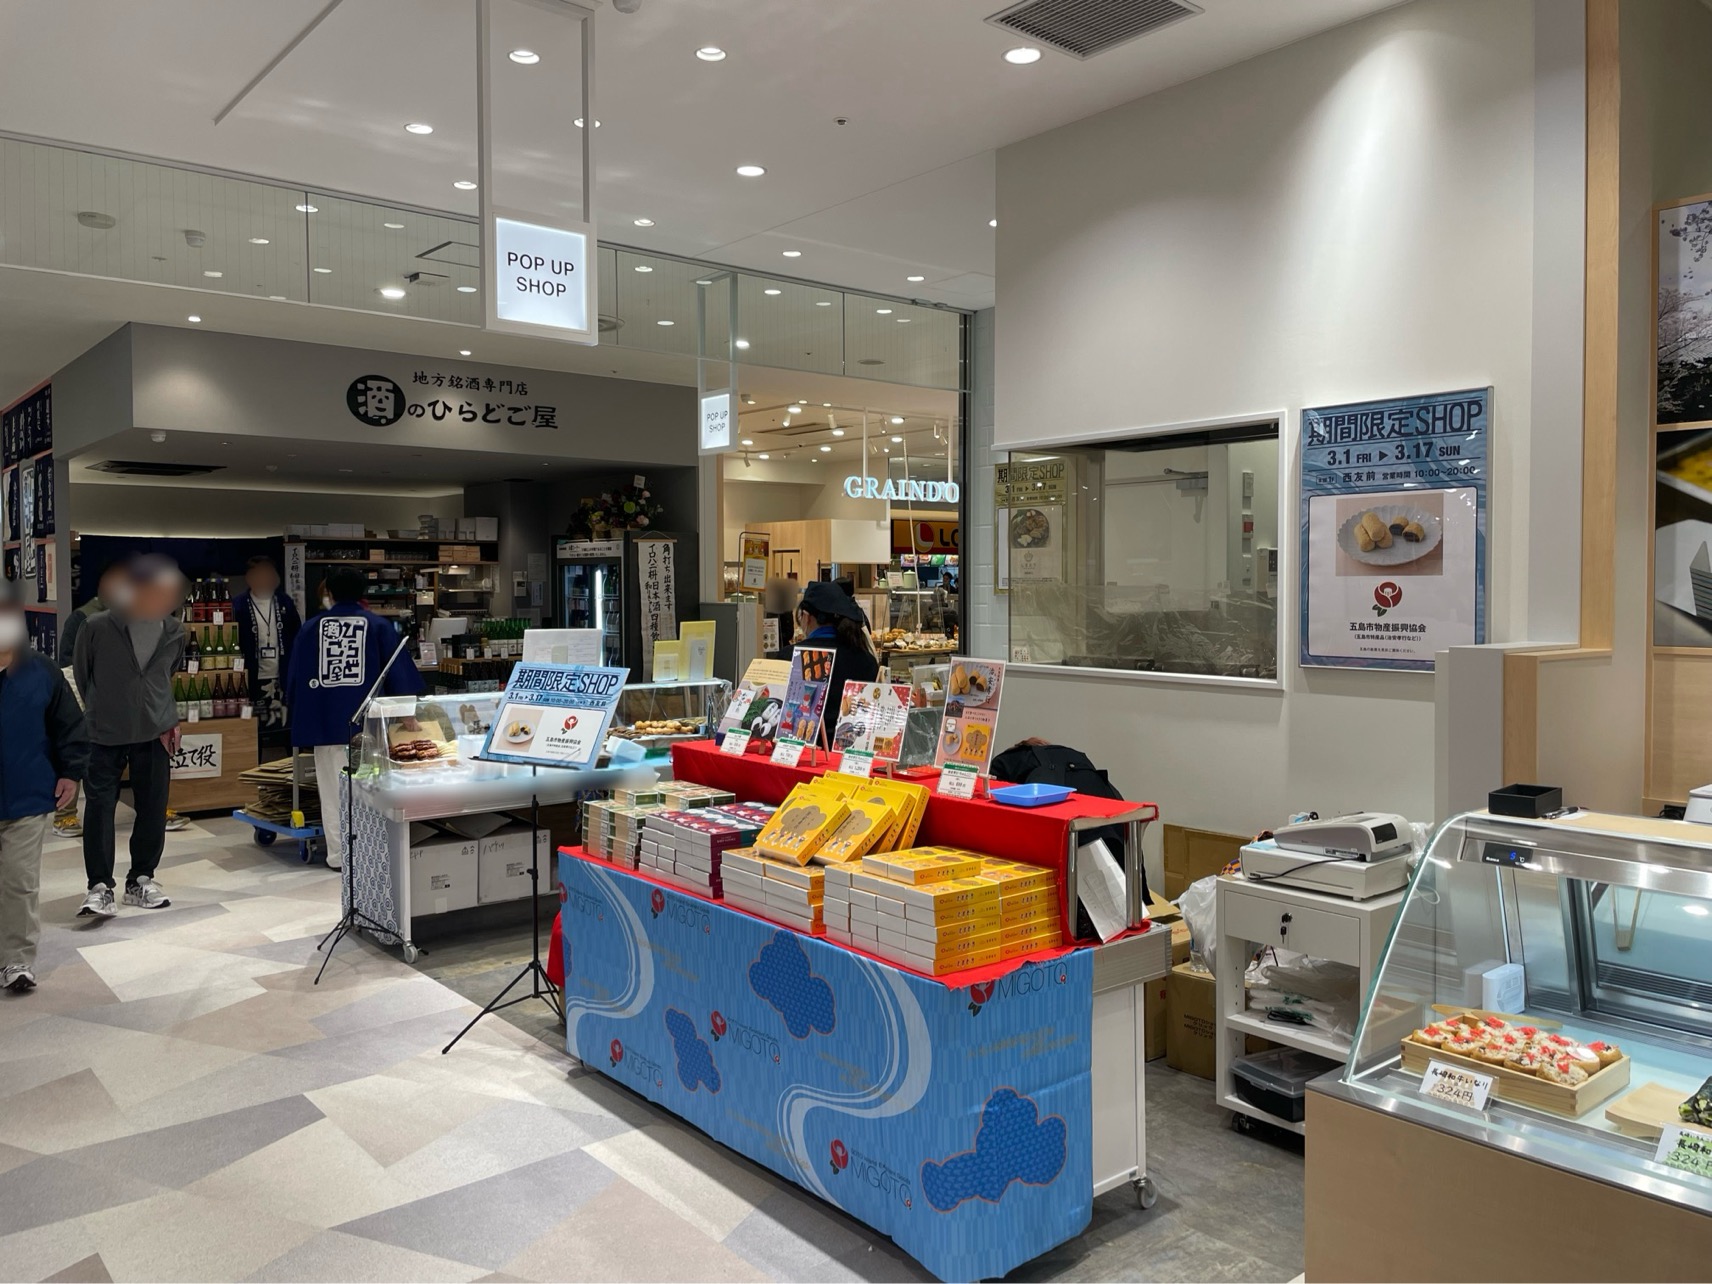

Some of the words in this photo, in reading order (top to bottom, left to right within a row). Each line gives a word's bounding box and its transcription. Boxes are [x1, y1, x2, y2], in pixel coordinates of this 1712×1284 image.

[507, 251, 545, 271] POP
[551, 259, 575, 276] UP
[516, 276, 567, 297] SHOP
[412, 370, 529, 396] 地方銘酒専門店
[707, 411, 719, 422] POP
[720, 410, 729, 420] UP
[1307, 401, 1483, 447] 期間限定SHOP
[709, 422, 726, 433] SHOP
[1327, 449, 1350, 466] 3.1
[1356, 453, 1372, 464] FRI
[1395, 441, 1434, 461] 3.17
[1438, 445, 1461, 457] SUN
[1342, 471, 1376, 483] 西友前
[1349, 621, 1427, 633] 五島市物産振興協会
[513, 668, 619, 696] 期間限定SHOP
[528, 693, 543, 702] 3.17
[169, 744, 217, 769] 立て役
[1436, 1083, 1474, 1102] 324円
